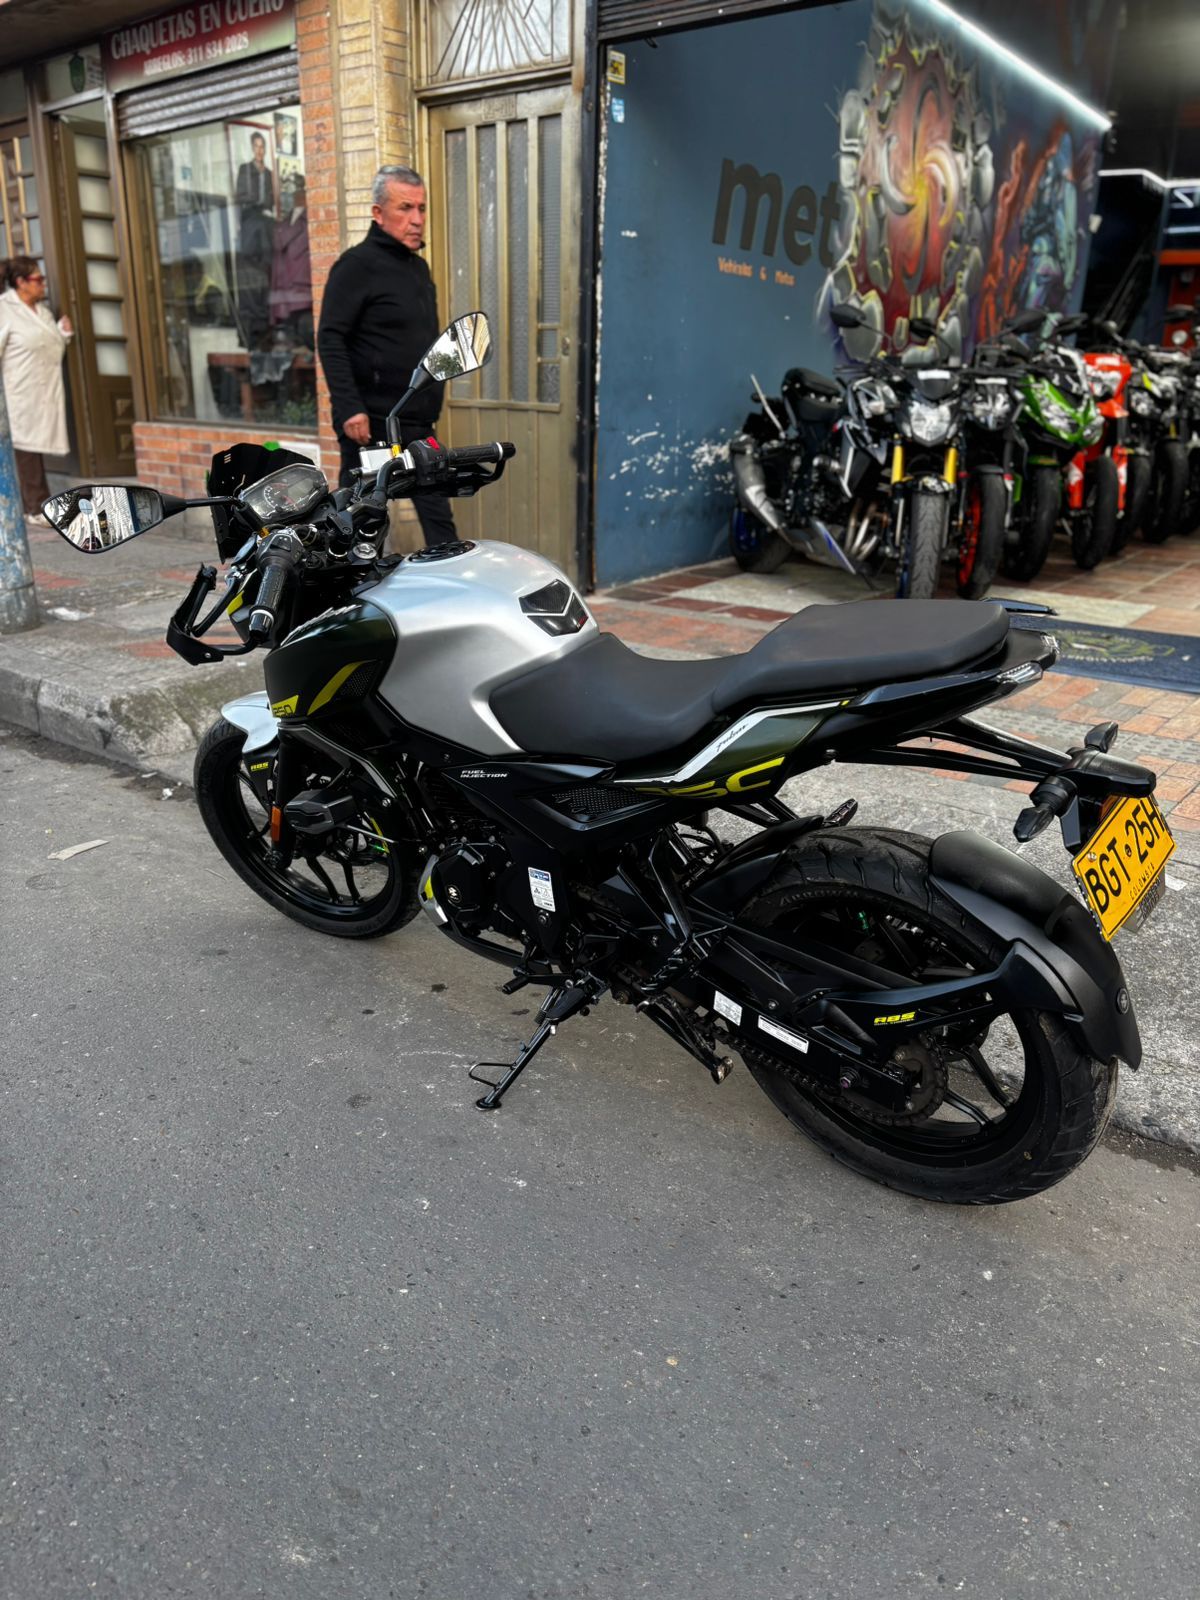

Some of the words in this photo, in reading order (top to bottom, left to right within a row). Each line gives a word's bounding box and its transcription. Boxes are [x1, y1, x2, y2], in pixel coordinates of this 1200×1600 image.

[110, 9, 196, 60] CHAQUETAS
[200, 0, 221, 34] EN
[712, 157, 839, 270] met
[1084, 837, 1131, 915] BGT
[1125, 799, 1165, 865] 25H
[873, 1011, 916, 1024] ABS
